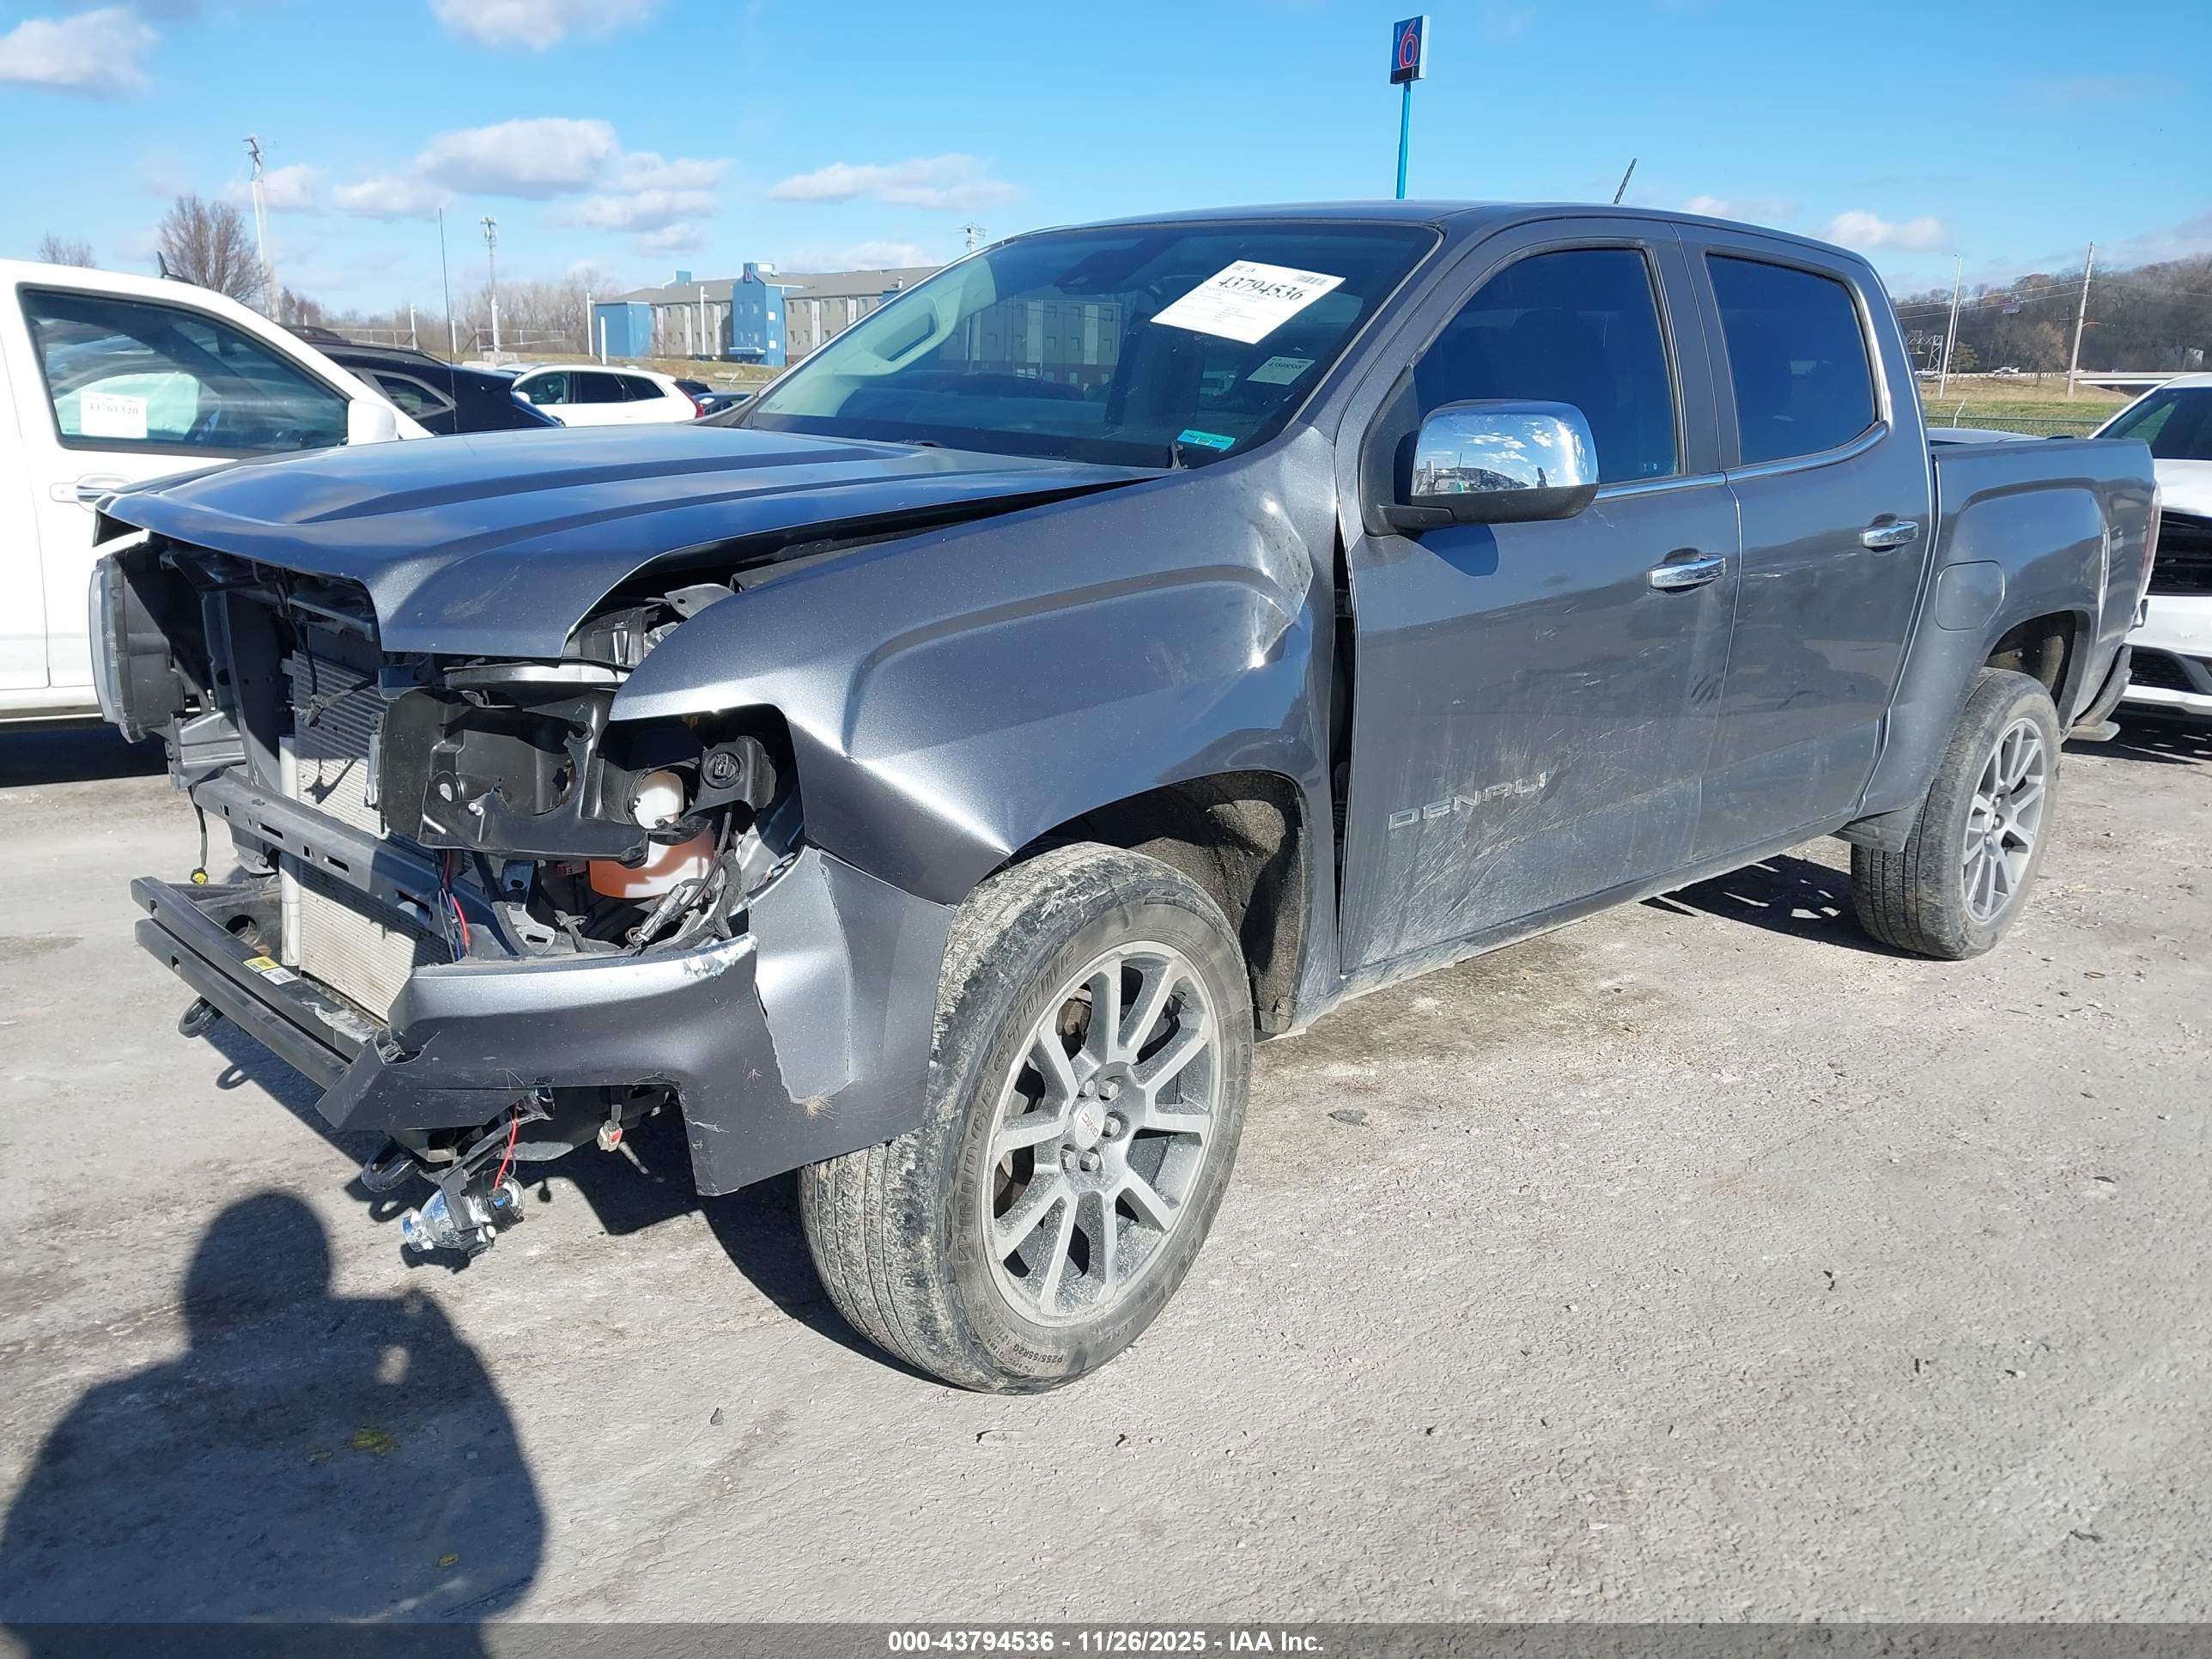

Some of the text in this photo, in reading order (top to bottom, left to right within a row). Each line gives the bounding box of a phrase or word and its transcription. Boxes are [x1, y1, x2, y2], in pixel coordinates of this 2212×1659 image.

[1399, 20, 1419, 68] 6
[1218, 275, 1312, 301] 43794536
[1082, 1113, 1099, 1138] GMC
[1012, 1343, 1065, 1364] P255/55R20
